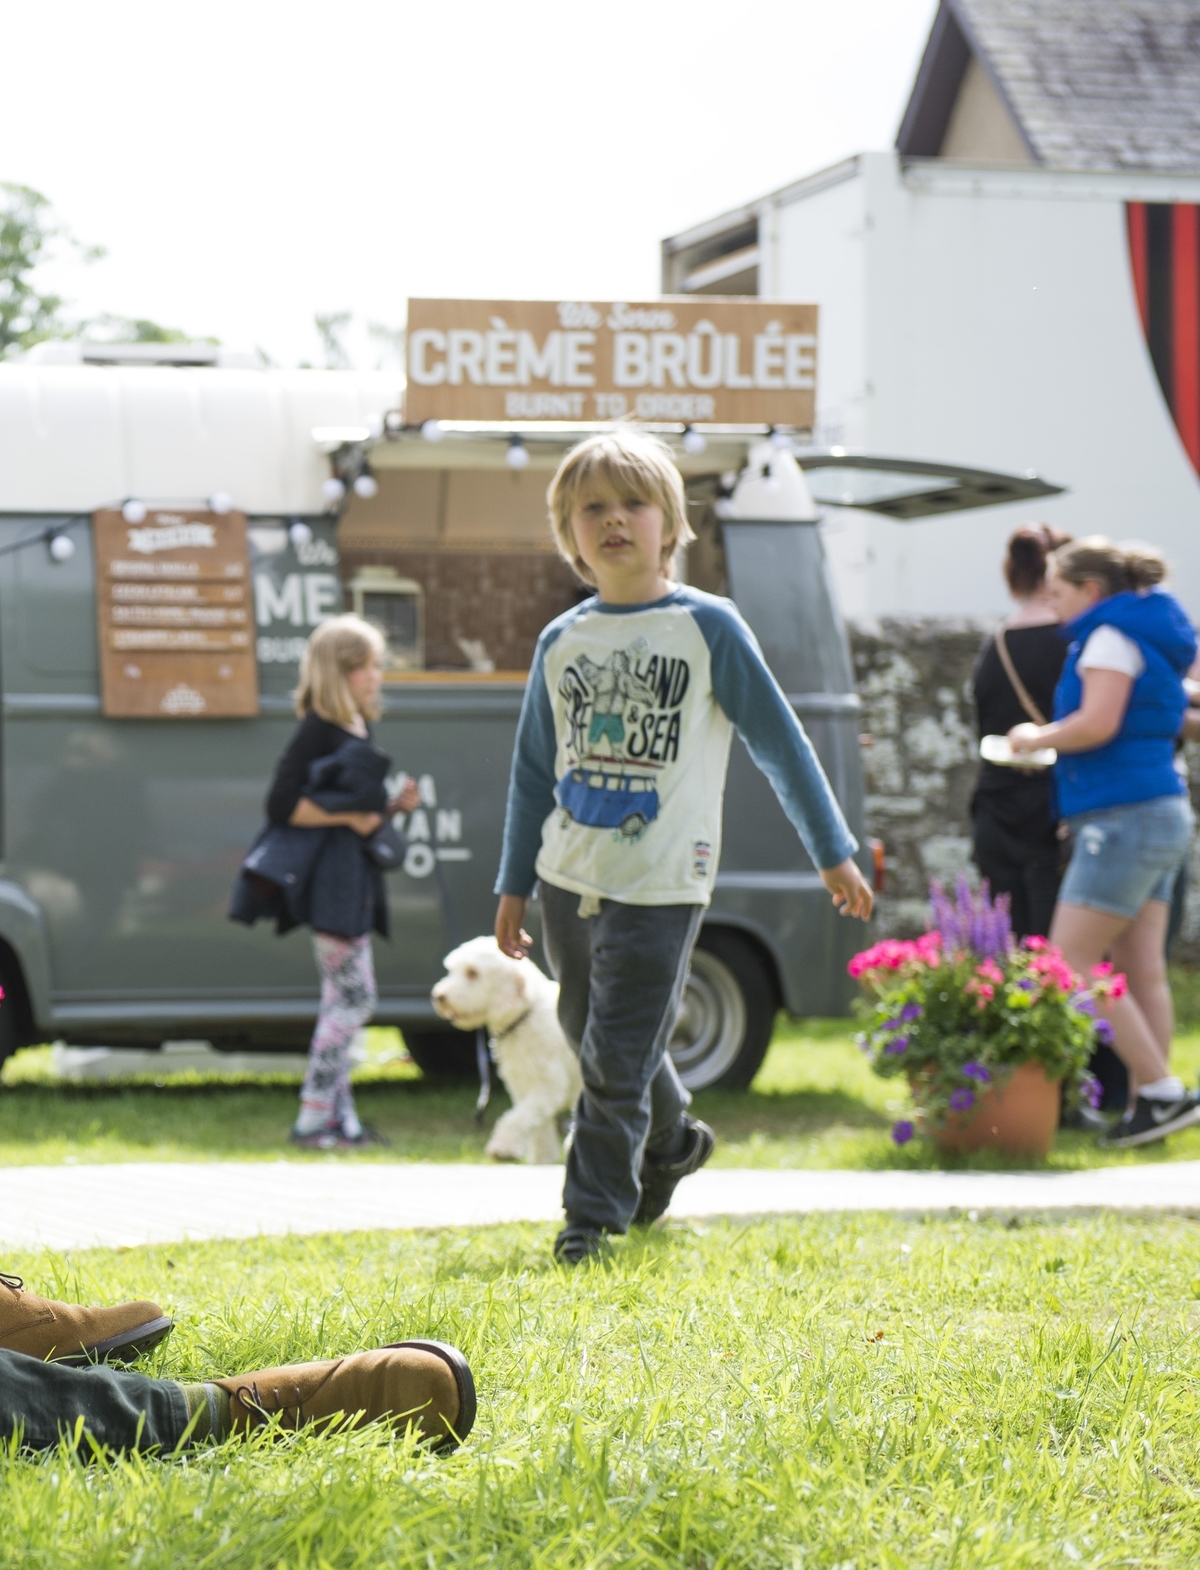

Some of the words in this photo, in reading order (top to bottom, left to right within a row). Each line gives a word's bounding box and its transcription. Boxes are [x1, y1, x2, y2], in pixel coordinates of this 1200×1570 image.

[409, 317, 597, 388] CRÈME
[613, 320, 816, 390] BRÛLÉE
[504, 391, 585, 418] BURNT
[592, 393, 626, 419] TO
[635, 394, 716, 421] ORDER
[634, 654, 691, 709] LAND
[627, 704, 640, 725] &
[627, 711, 681, 765] SEA
